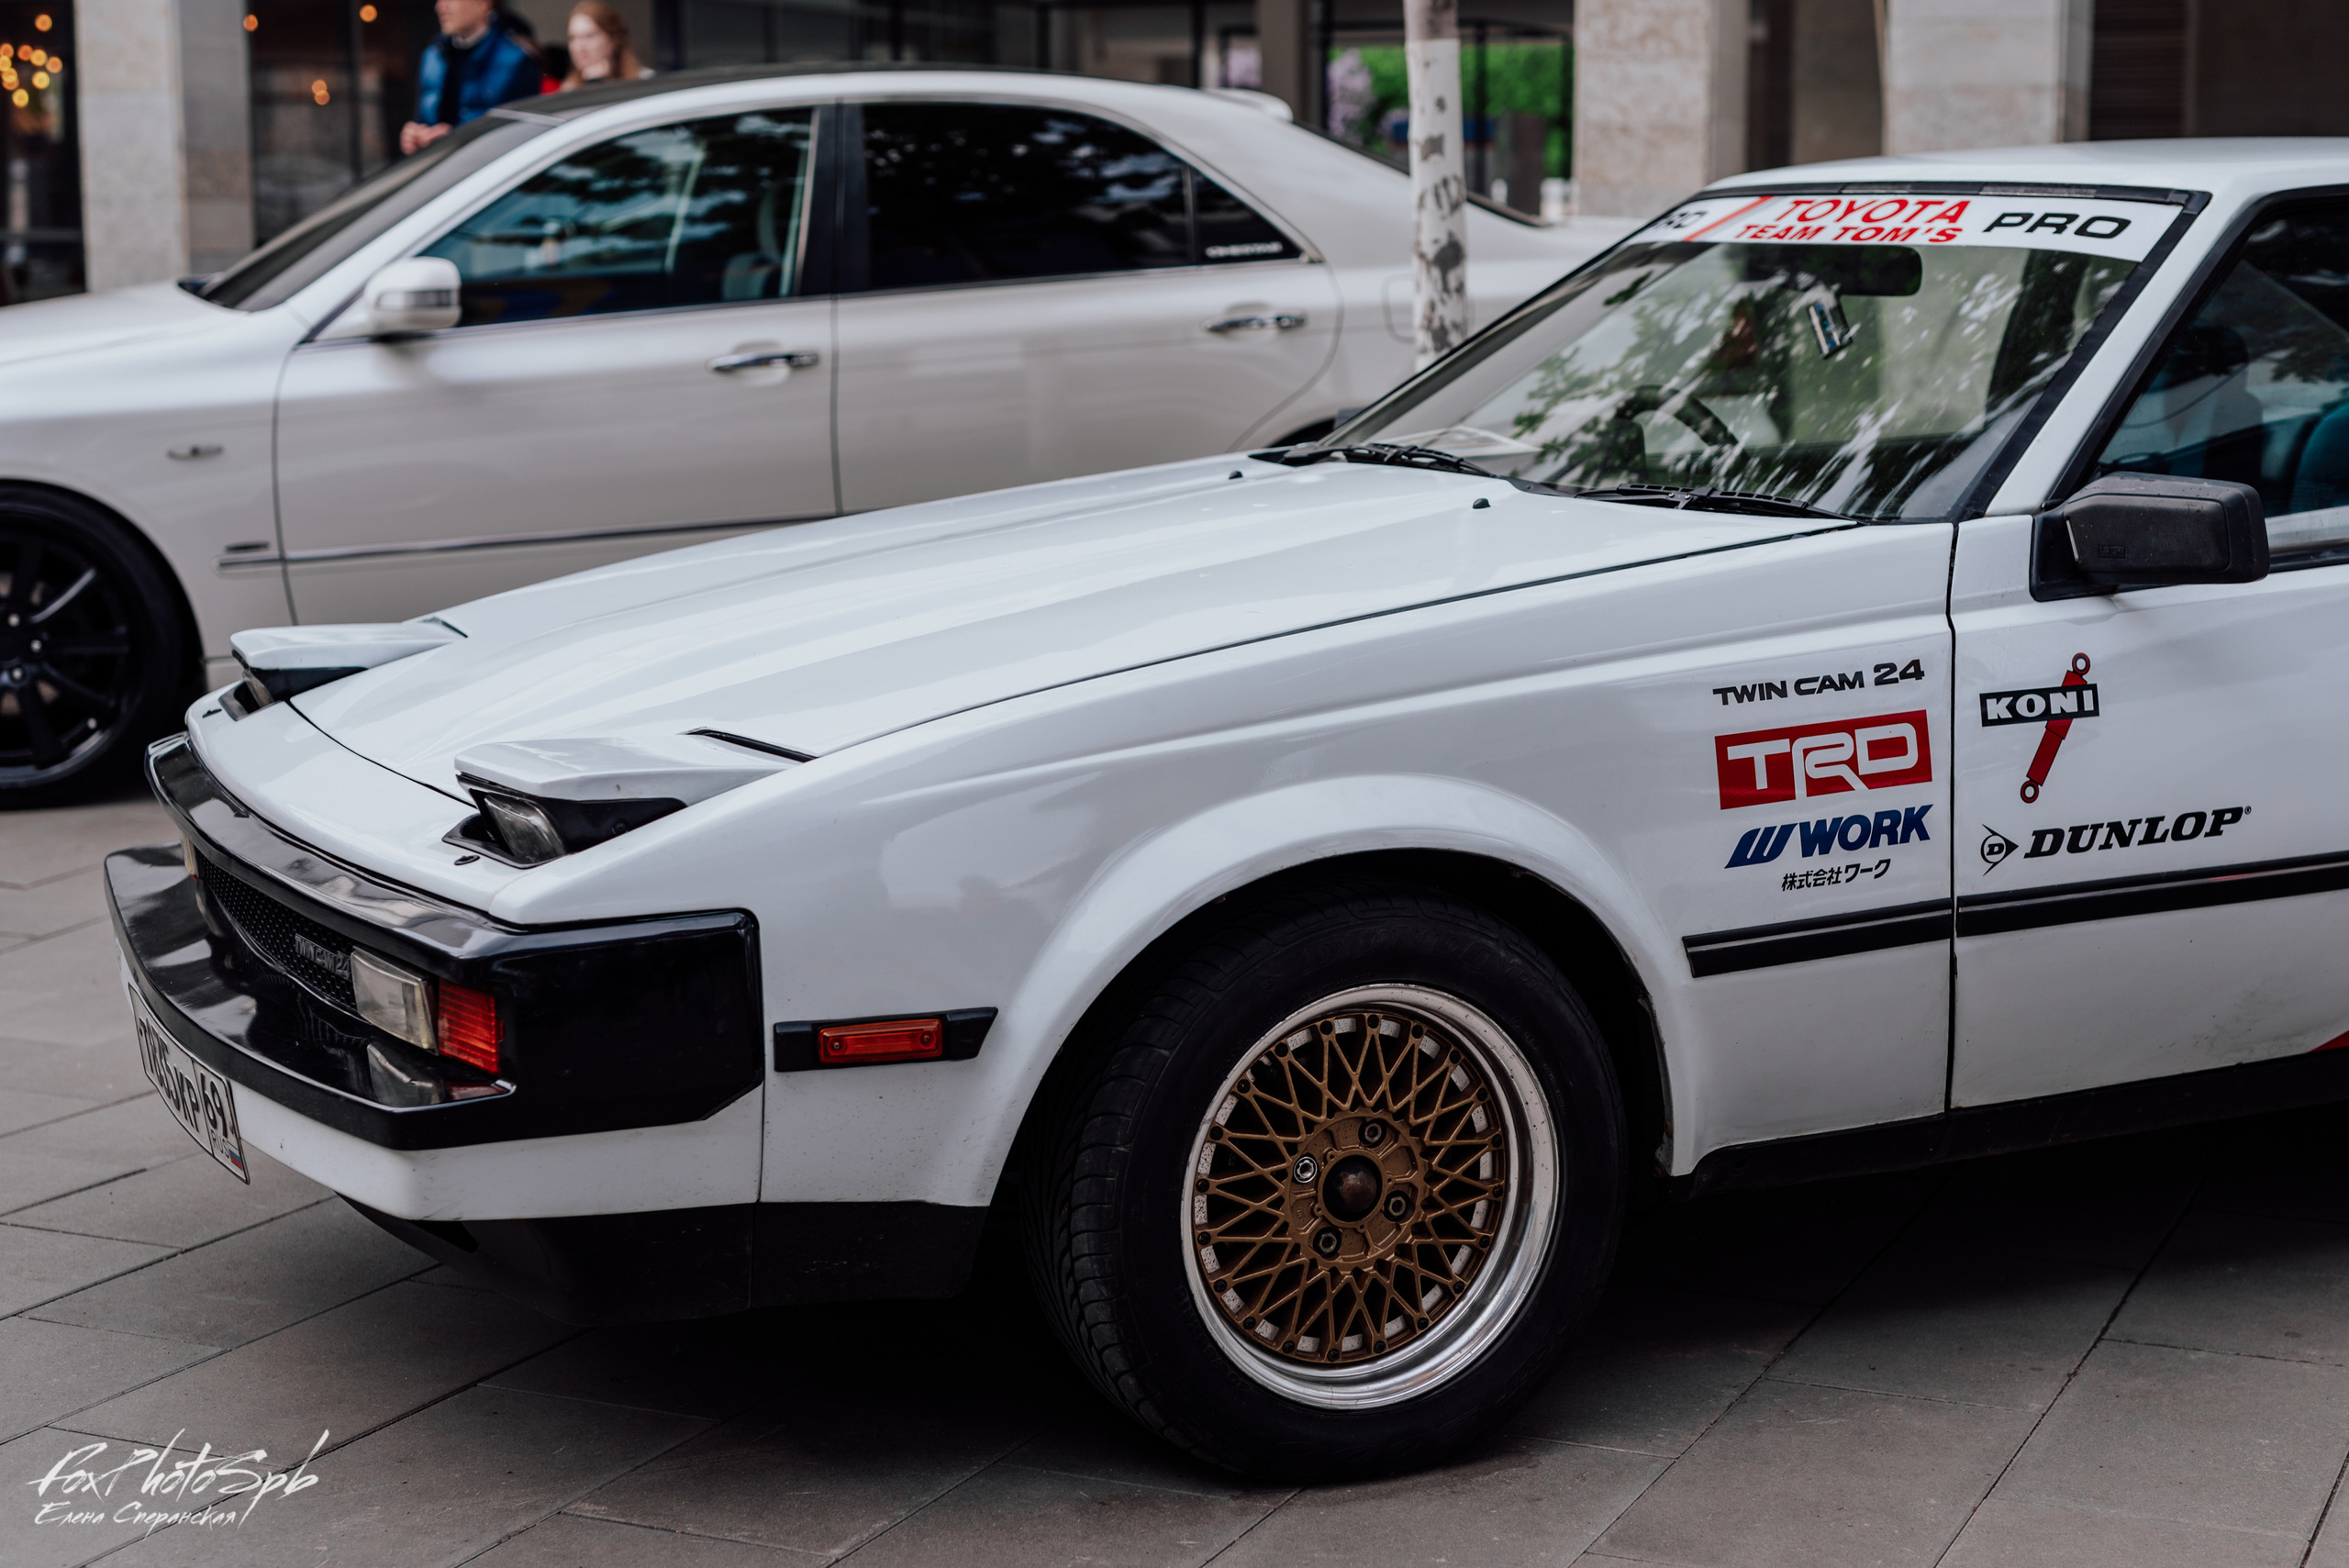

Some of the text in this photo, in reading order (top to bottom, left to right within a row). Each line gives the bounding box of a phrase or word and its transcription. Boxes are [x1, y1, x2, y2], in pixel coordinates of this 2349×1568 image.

[1775, 199, 1972, 224] TOYOTA
[1983, 212, 2132, 239] PRO
[1735, 225, 1962, 243] TEAM TOM'S
[1712, 659, 1925, 706] TWIN CAM 24
[1986, 689, 2095, 720] KONI
[1727, 722, 1920, 799] TRD
[1798, 804, 1934, 859] WORK
[2023, 806, 2244, 860] DUNLOP
[1781, 858, 1892, 892] 株式会社ワーク
[210, 1129, 229, 1159] RUS
